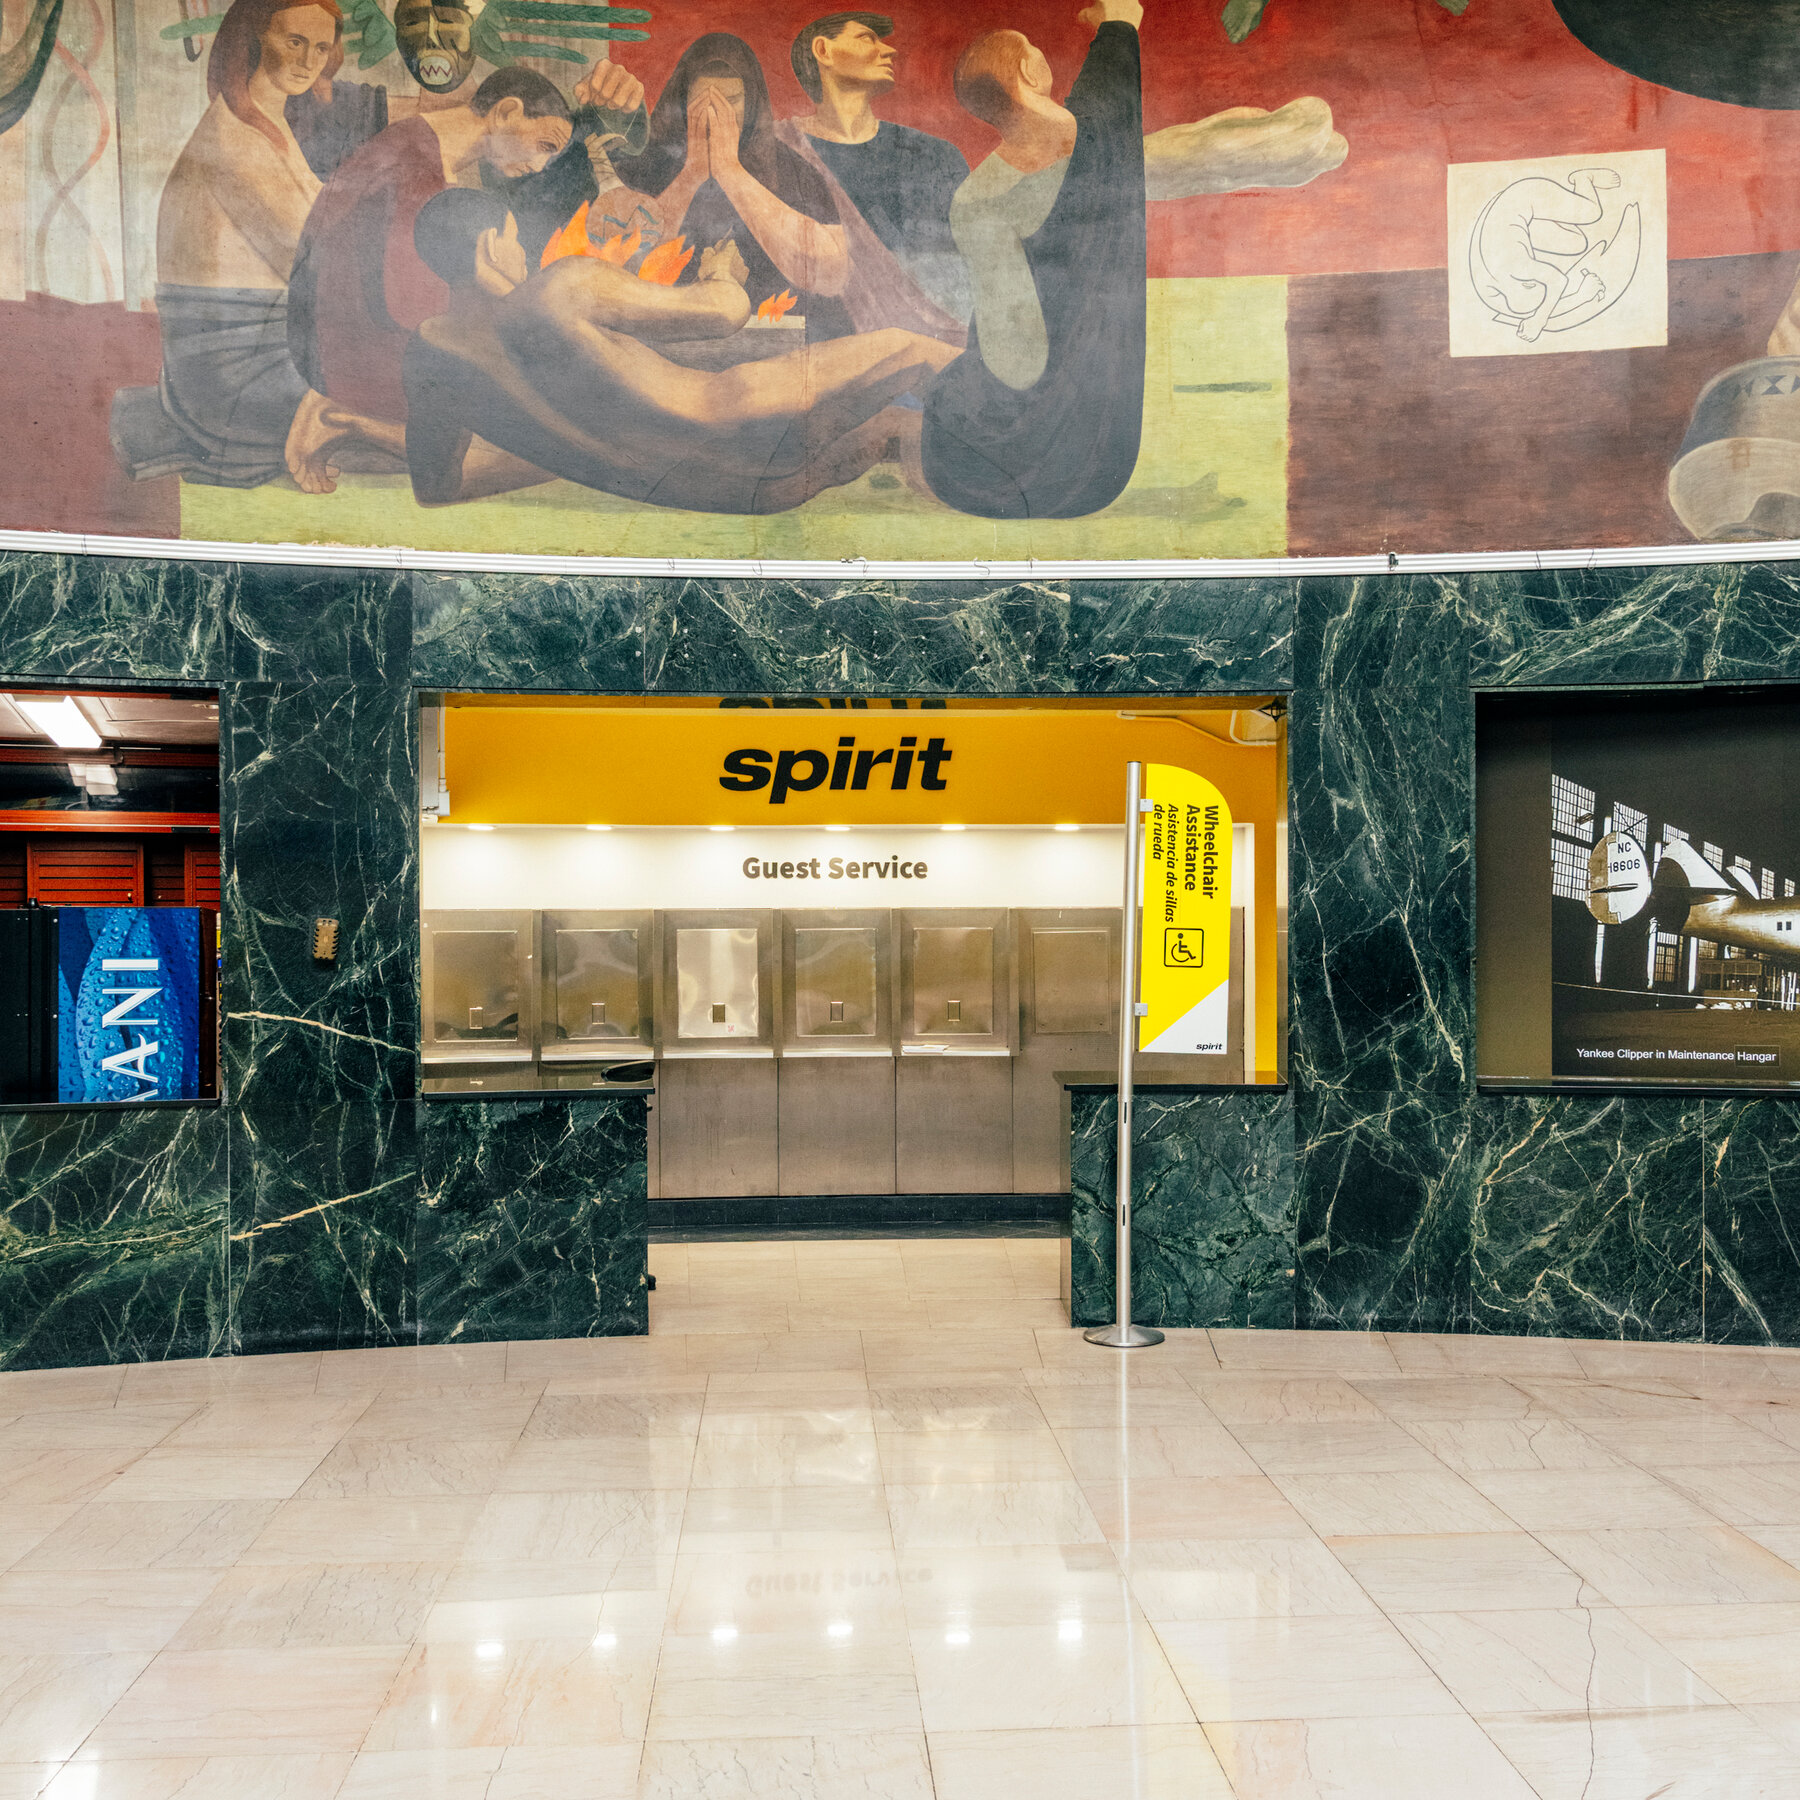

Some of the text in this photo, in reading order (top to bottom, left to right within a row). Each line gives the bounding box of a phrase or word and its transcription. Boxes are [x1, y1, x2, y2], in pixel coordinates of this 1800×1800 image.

[719, 736, 953, 804] spirit
[1152, 803, 1165, 860] de rueda
[1184, 804, 1202, 891] Assistance
[1617, 841, 1632, 853] NC
[742, 855, 928, 879] Guest Service
[1165, 803, 1179, 922] Asistencia de sillas
[1202, 805, 1219, 899] Wheelchair
[1609, 858, 1641, 873] 18606
[1195, 1043, 1223, 1051] spirit
[1576, 1048, 1777, 1063] Yankee Clipper in Maintenance Hangar
